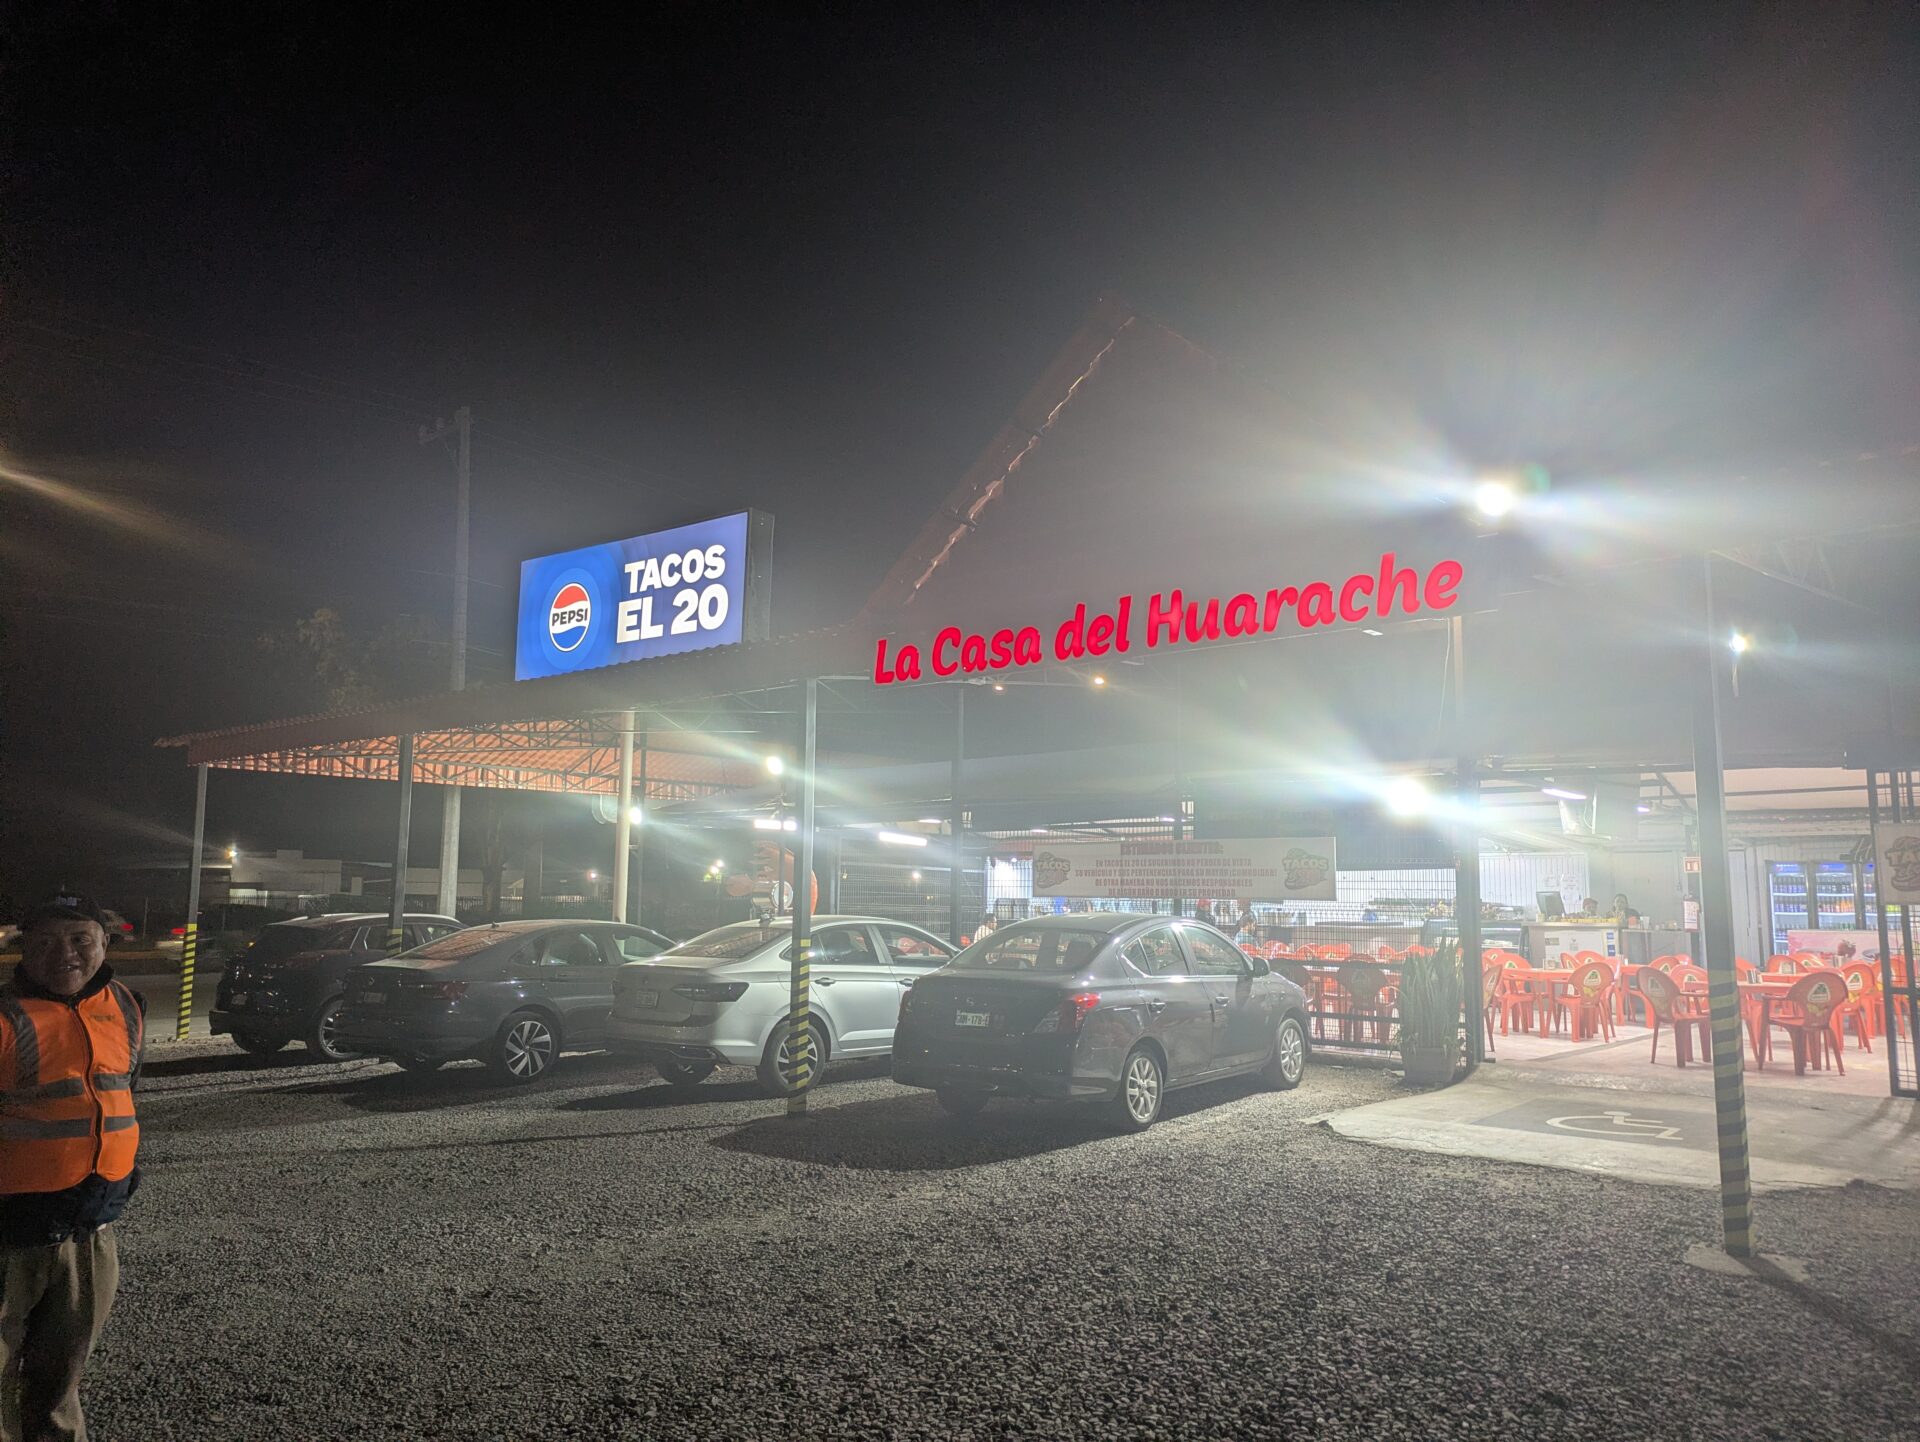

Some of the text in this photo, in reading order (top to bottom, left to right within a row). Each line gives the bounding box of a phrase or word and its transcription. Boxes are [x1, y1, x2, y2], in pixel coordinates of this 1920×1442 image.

[624, 544, 726, 594] TACOS
[551, 607, 588, 627] PEPSI
[616, 583, 729, 644] EL 20
[874, 552, 1464, 685] La Casa del Huarache
[1036, 860, 1070, 872] TACOS
[1282, 857, 1328, 871] TACOS
